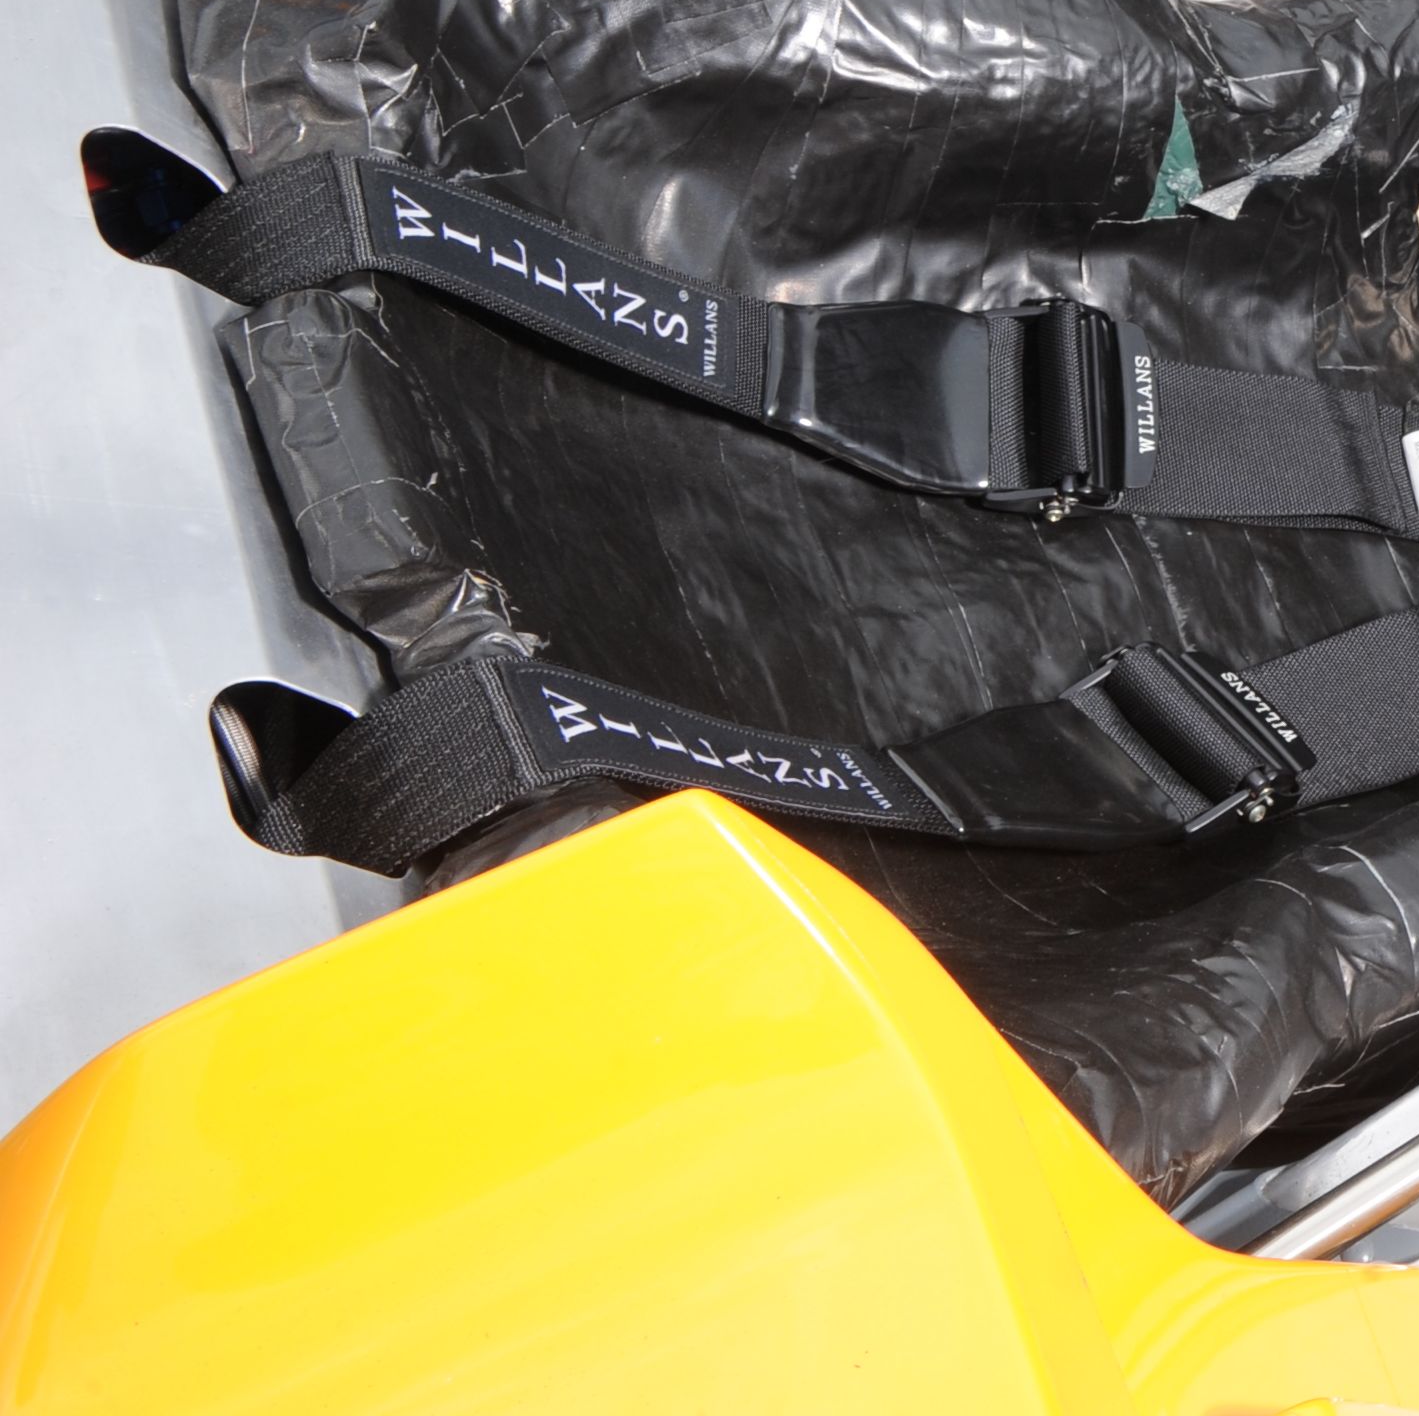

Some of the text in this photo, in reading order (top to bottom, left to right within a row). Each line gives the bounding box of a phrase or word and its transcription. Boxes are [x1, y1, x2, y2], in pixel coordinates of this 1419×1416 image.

[391, 186, 690, 345] WILLANS
[702, 299, 718, 378] WILLANS
[1135, 354, 1154, 454] WILLANS
[541, 684, 850, 793] WILLANS
[1221, 671, 1300, 744] WILLANS
[836, 751, 893, 811] WILLANS
